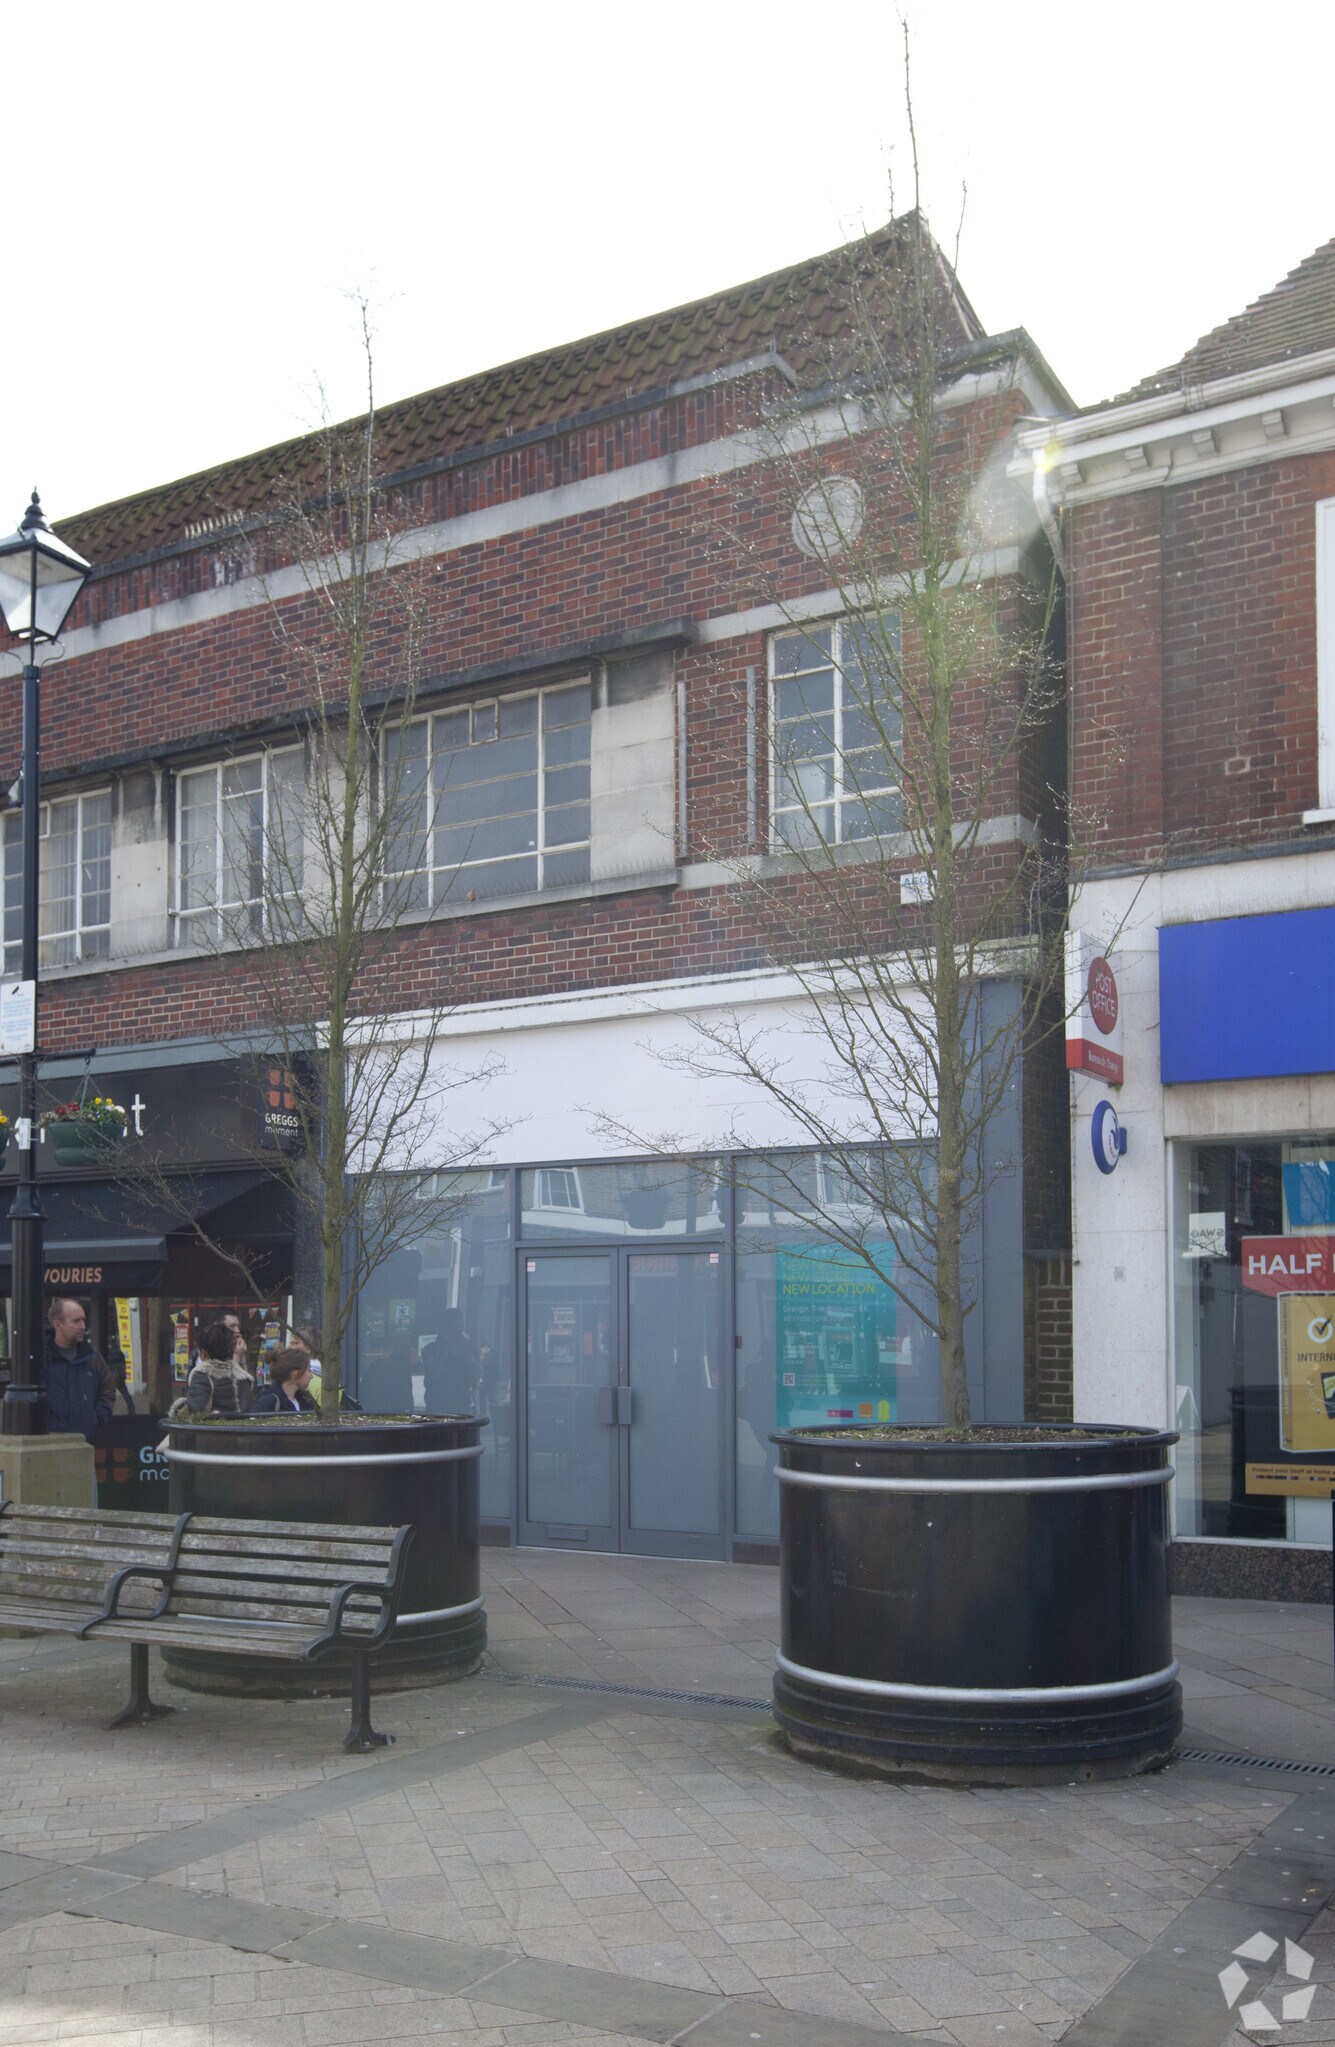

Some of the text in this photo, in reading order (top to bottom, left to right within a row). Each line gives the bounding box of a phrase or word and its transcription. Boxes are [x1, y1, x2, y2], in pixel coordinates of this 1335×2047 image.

[1095, 973, 1112, 994] POST
[1092, 990, 1116, 1017] OFFICE
[265, 1112, 299, 1127] GREGGS
[1248, 1253, 1322, 1275] HALF
[783, 1271, 808, 1282] NEW
[783, 1283, 809, 1295] NEW
[859, 1304, 869, 1312] EE
[792, 1314, 812, 1322] under
[1297, 1352, 1335, 1362] INTERN
